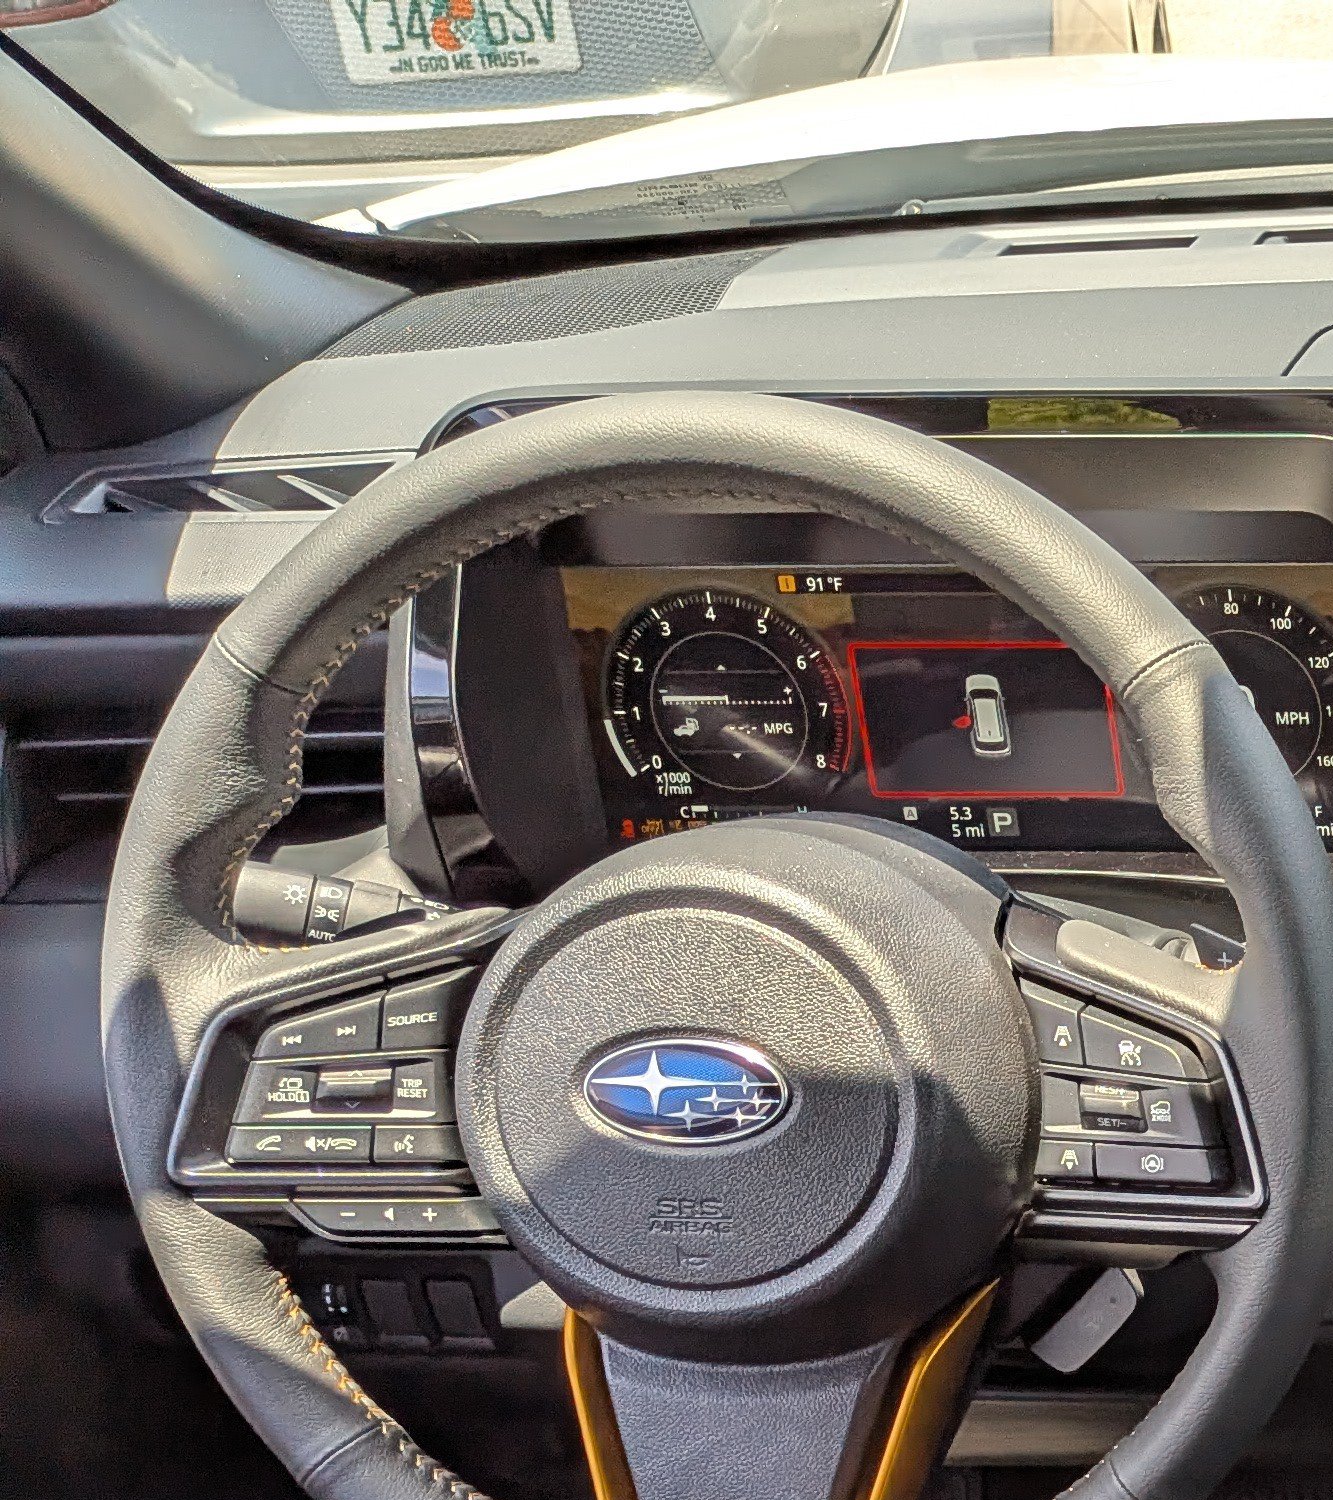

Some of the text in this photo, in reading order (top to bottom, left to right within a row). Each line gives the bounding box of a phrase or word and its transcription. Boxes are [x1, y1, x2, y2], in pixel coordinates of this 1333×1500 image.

[479, 51, 528, 69] TRUST
[705, 606, 717, 621] 4
[1223, 602, 1239, 615] 80
[661, 621, 671, 636] 3
[757, 619, 768, 634] 5
[1270, 617, 1292, 630] 100
[632, 657, 644, 672] 2
[796, 655, 807, 670] 6
[1308, 656, 1330, 669] 120
[632, 707, 641, 721] 1
[818, 702, 828, 718] 7
[1275, 711, 1310, 725] MPH
[764, 722, 793, 735] MPG
[652, 755, 662, 770] 0
[816, 754, 826, 769] 8
[680, 806, 690, 819] C
[949, 806, 973, 821] 5.3
[993, 812, 1013, 833] P
[951, 823, 985, 838] 5 mi
[387, 1011, 438, 1027] SOURCE
[402, 1078, 422, 1088] TRIP
[267, 1091, 296, 1102] HOLD
[396, 1088, 427, 1099] RESET
